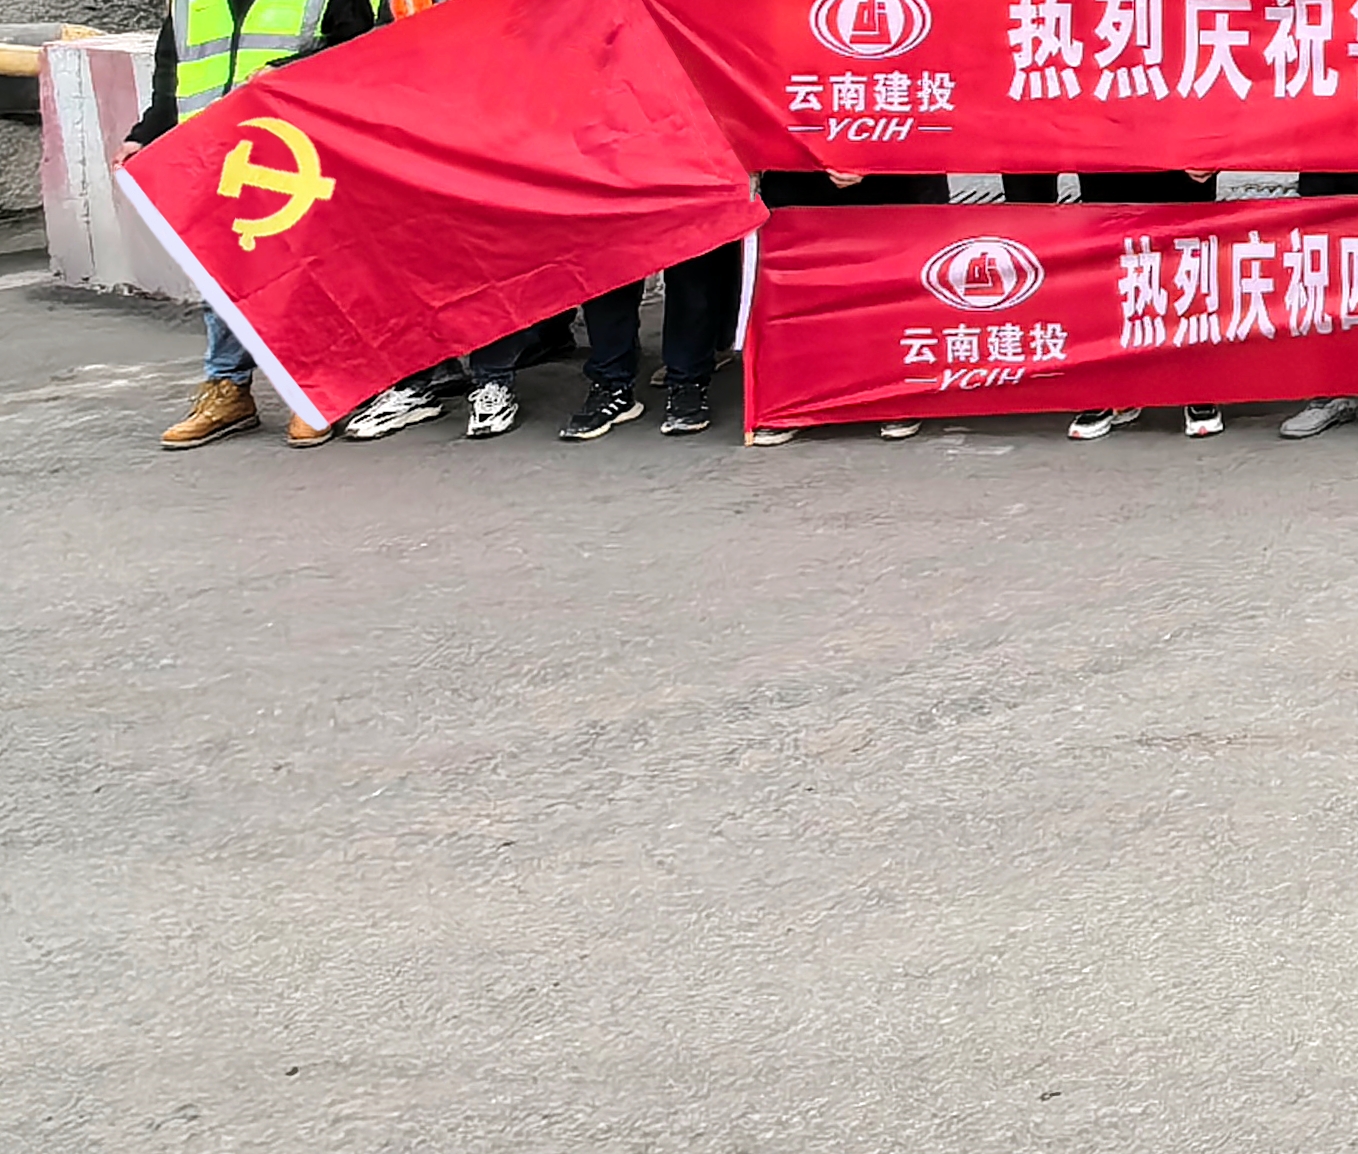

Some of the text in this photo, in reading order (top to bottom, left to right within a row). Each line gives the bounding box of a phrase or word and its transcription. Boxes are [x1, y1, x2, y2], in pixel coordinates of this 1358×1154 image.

[786, 71, 956, 113] 云南建投
[818, 117, 914, 142] YCIH
[900, 323, 1068, 364] 云南建投
[938, 366, 1026, 392] YCIH
